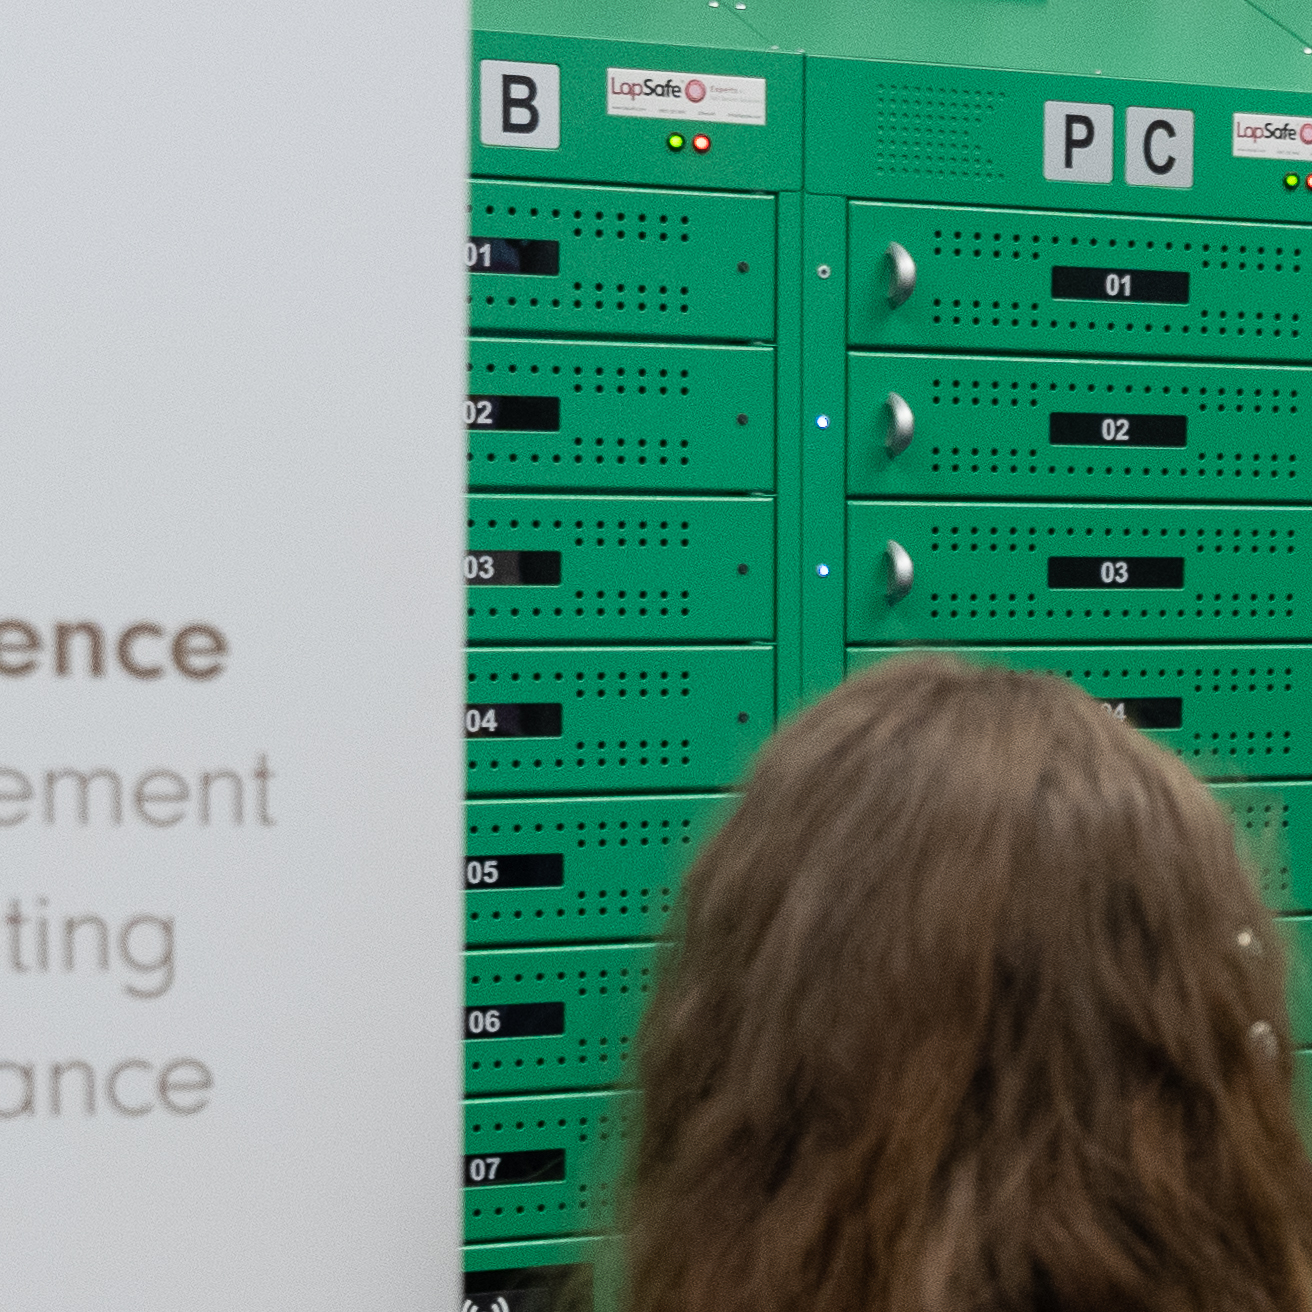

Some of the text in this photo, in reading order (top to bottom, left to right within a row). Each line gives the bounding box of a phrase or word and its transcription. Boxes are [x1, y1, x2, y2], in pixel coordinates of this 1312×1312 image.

[611, 77, 682, 101] LapSafe
[500, 73, 541, 135] B
[1237, 122, 1297, 143] LapSafe
[464, 242, 492, 268] 01
[1105, 273, 1131, 297] 01
[462, 400, 493, 424] 02
[1101, 419, 1130, 441] 02
[462, 557, 495, 580] 03
[1100, 562, 1129, 585] 03
[0, 617, 231, 682] ence
[465, 710, 498, 733] 04
[466, 861, 499, 884] 05
[3, 895, 177, 1000] ting
[468, 1009, 502, 1034] 06
[469, 1158, 502, 1181] 07
